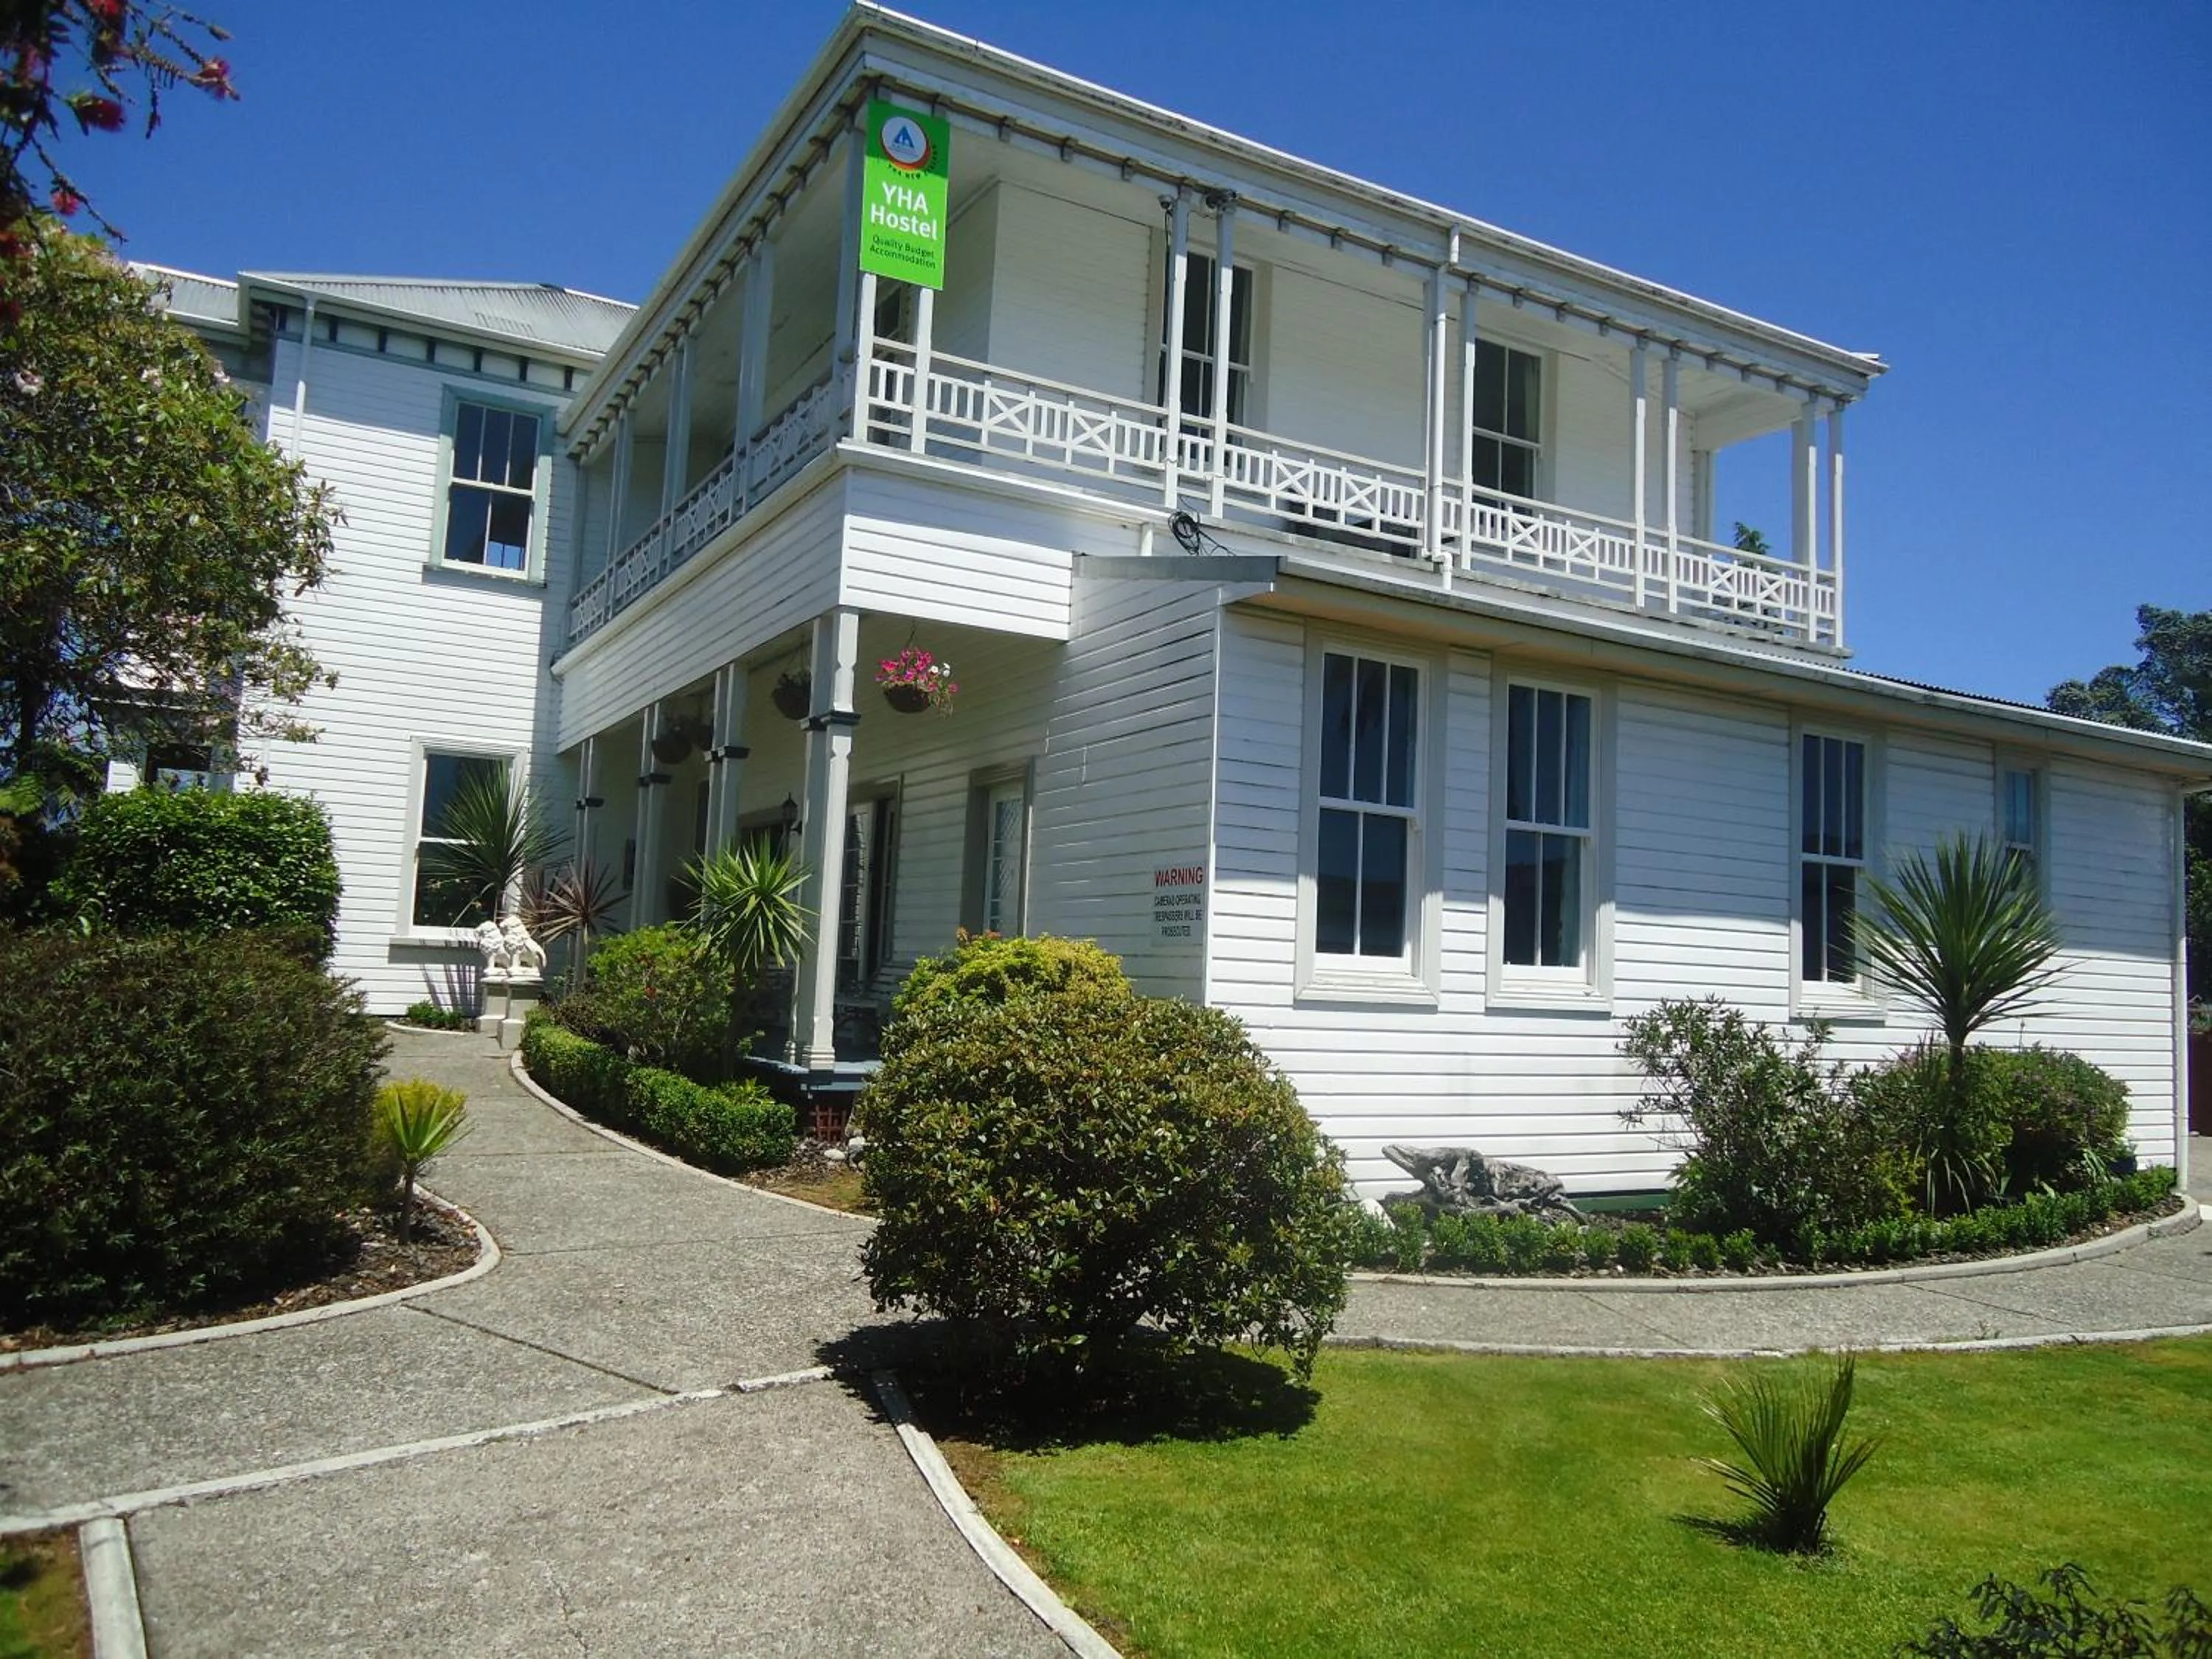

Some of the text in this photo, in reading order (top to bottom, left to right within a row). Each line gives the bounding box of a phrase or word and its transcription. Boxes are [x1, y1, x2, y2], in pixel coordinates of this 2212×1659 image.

[882, 181, 929, 215] YHA
[870, 203, 938, 240] Hostel
[870, 244, 936, 269] Accommodation
[873, 234, 934, 258] Quality Budget
[1155, 866, 1203, 888] WARNING
